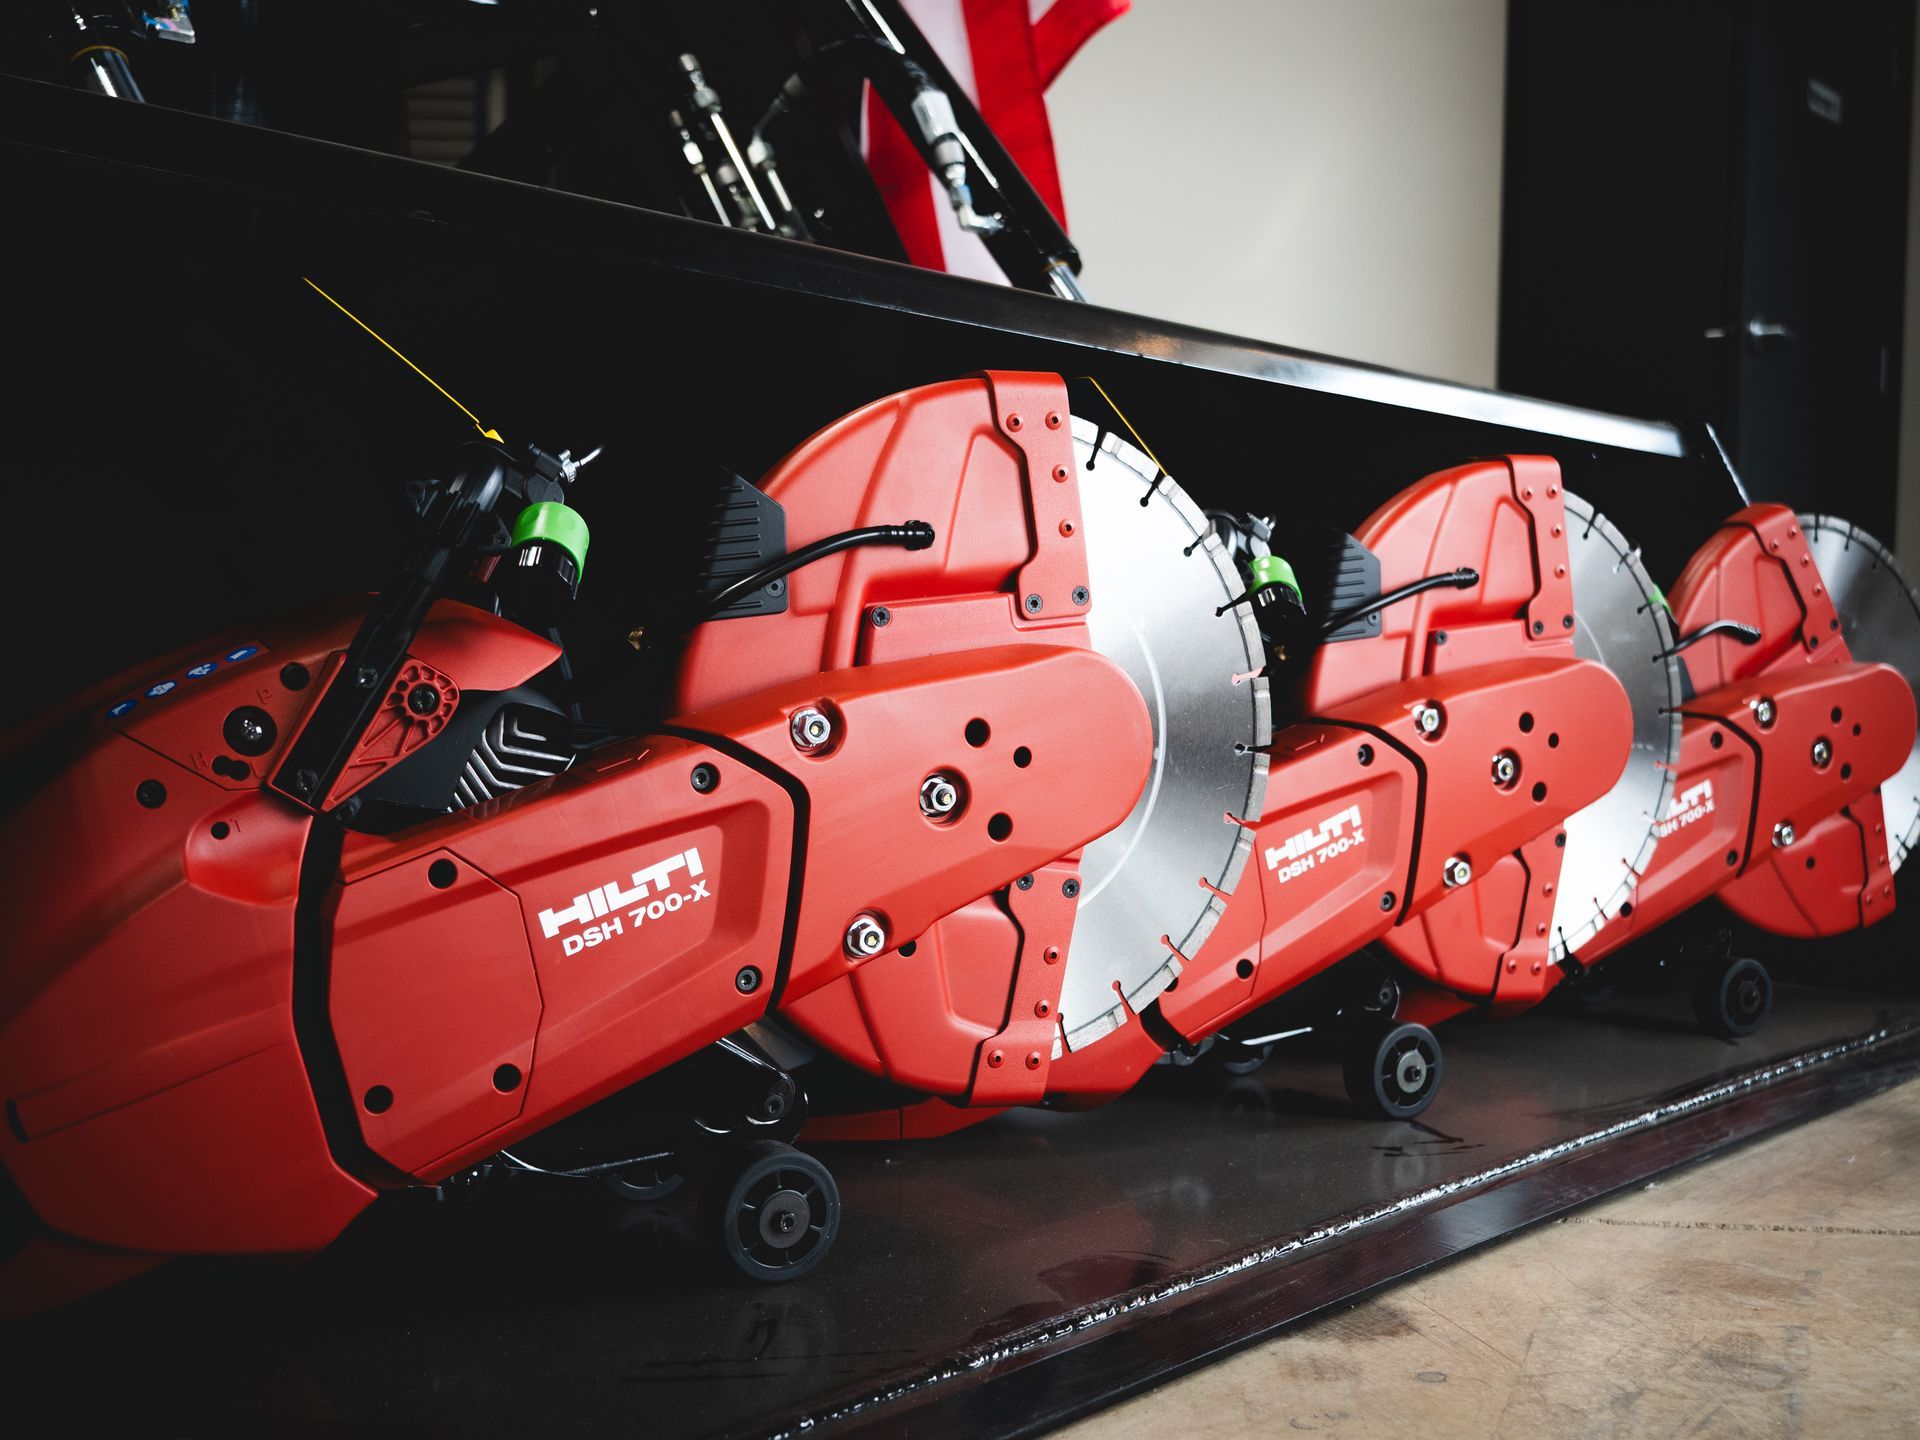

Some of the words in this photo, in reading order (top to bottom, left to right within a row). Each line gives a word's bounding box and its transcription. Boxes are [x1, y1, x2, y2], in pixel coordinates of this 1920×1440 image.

[1264, 804, 1362, 871] HILTI
[1679, 798, 1714, 828] 700-X
[1277, 854, 1315, 884] DSH
[1316, 828, 1366, 864] 700-X
[537, 847, 704, 939] HILTI
[562, 917, 624, 957] DSH
[628, 879, 711, 928] 700-X
